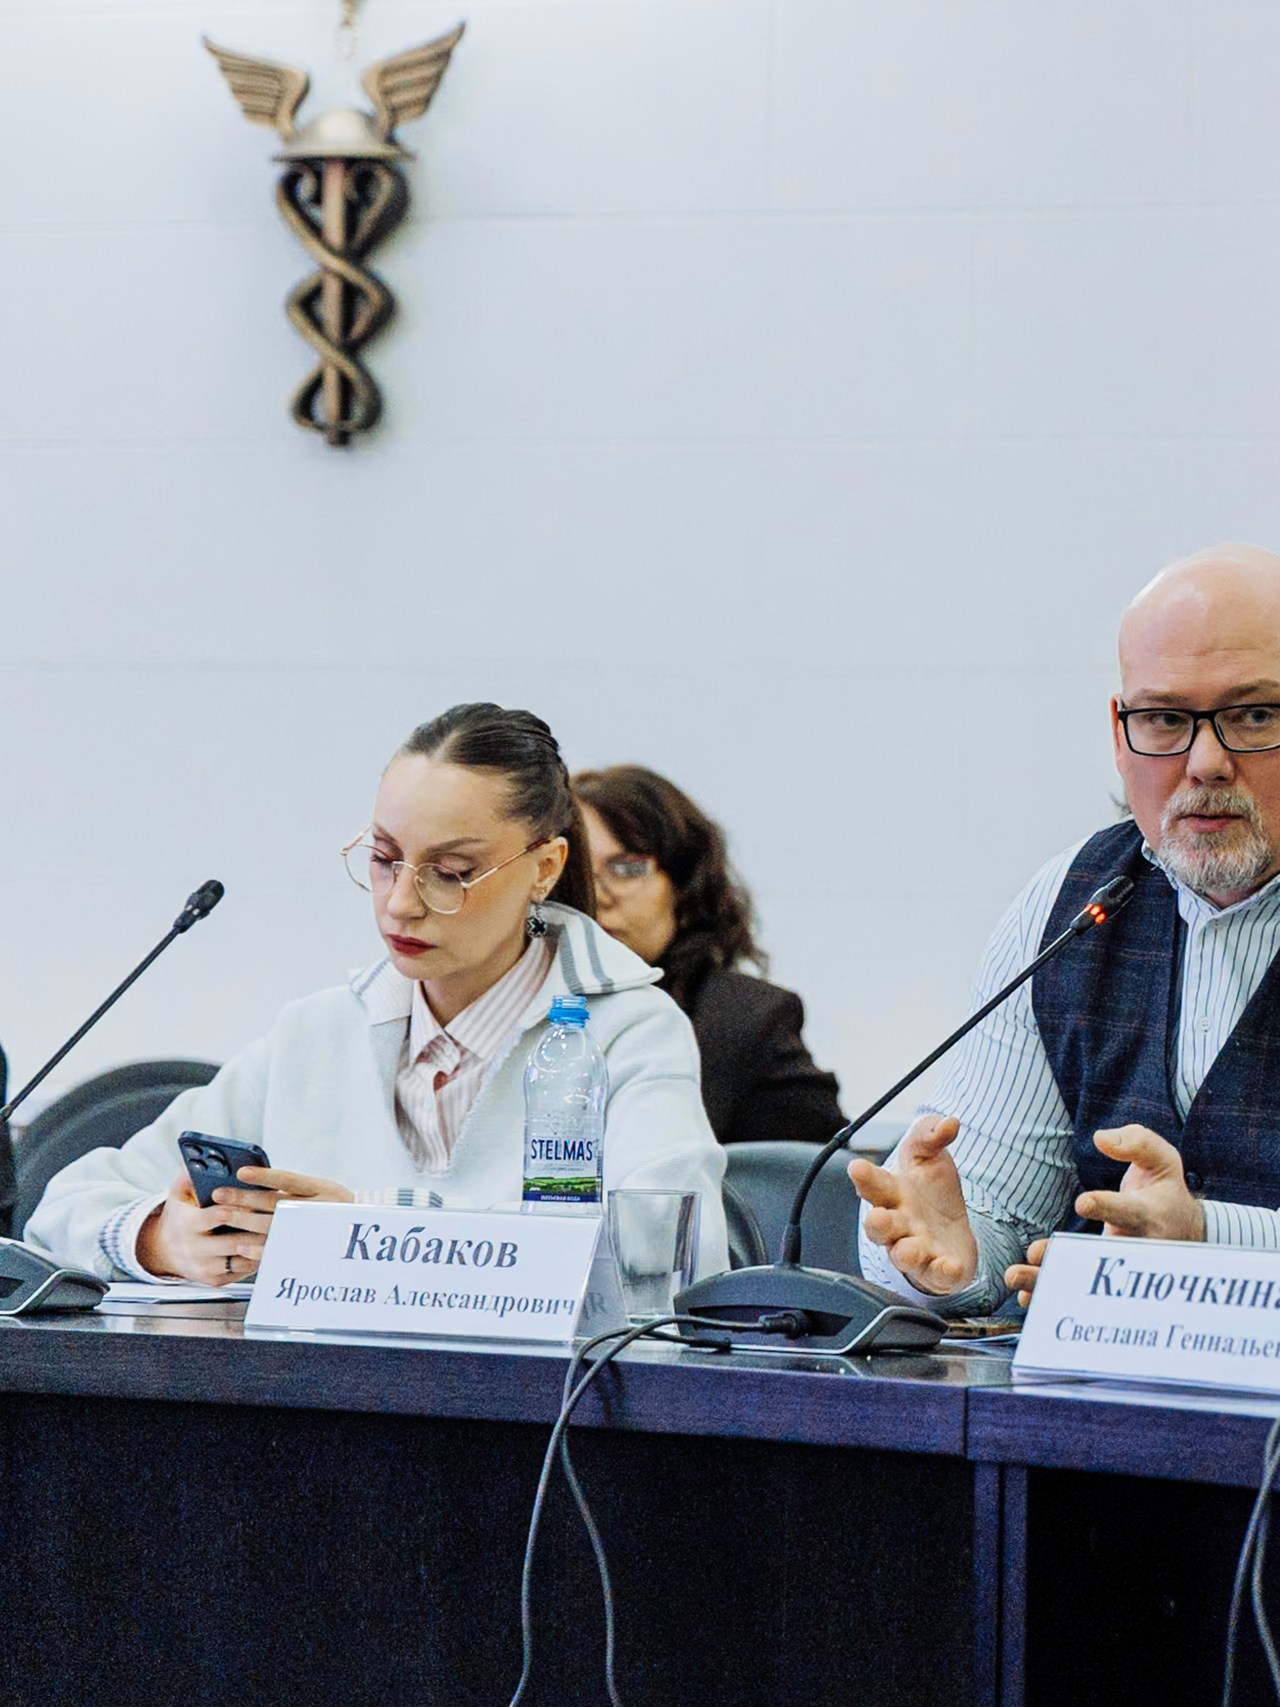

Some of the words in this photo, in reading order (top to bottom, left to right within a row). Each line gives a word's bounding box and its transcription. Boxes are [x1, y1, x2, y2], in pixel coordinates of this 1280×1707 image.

[531, 1139, 593, 1161] STELMAS
[342, 1222, 519, 1268] Кабаков
[275, 1277, 376, 1307] Ярослав
[384, 1283, 575, 1318] Александрович
[1054, 1316, 1159, 1349] Светлана
